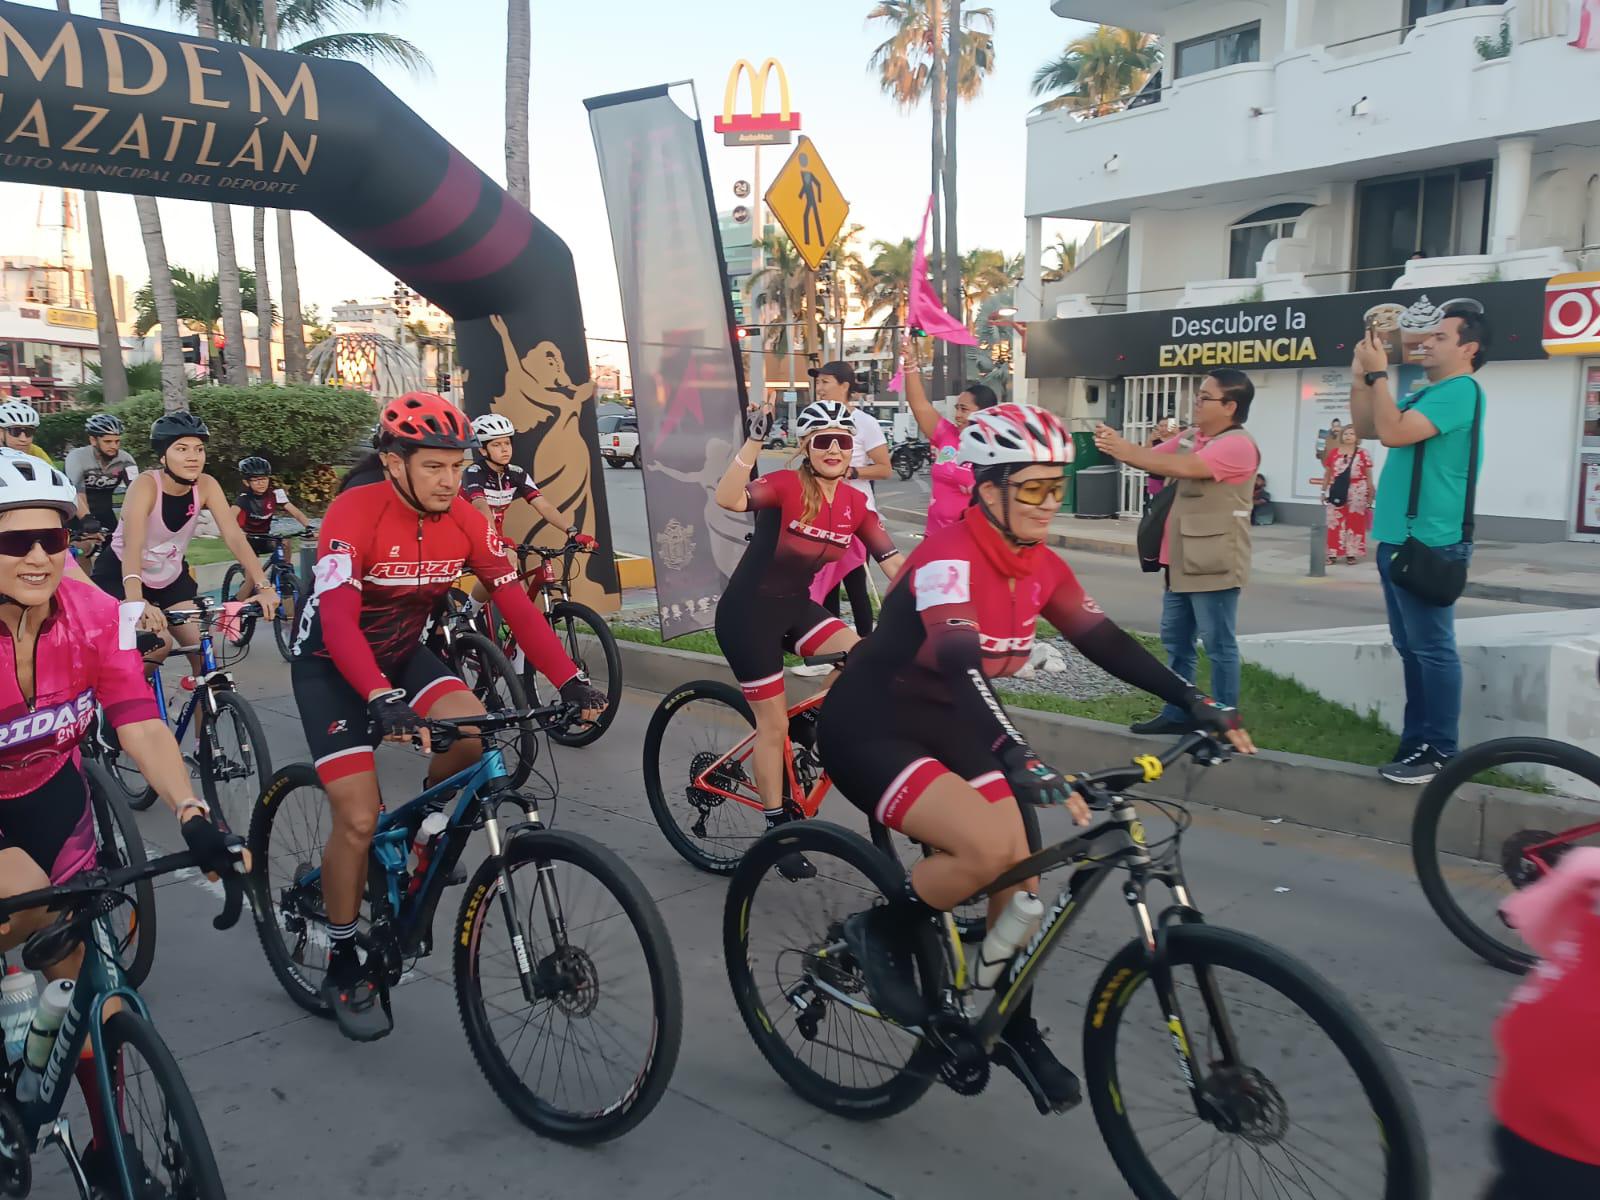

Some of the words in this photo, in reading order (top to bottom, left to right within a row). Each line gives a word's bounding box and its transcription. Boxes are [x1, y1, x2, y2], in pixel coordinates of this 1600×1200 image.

[0, 93, 318, 175] AZATLÁN
[58, 160, 171, 182] MUNICIPAL
[178, 172, 211, 186] DEL
[217, 176, 300, 194] DEPORTE
[1171, 310, 1277, 338] Descubre
[1285, 306, 1306, 330] la
[1159, 336, 1317, 368] EXPERIENCIA
[460, 884, 487, 948] MAXXIS
[39, 1002, 83, 1104] GIANT
